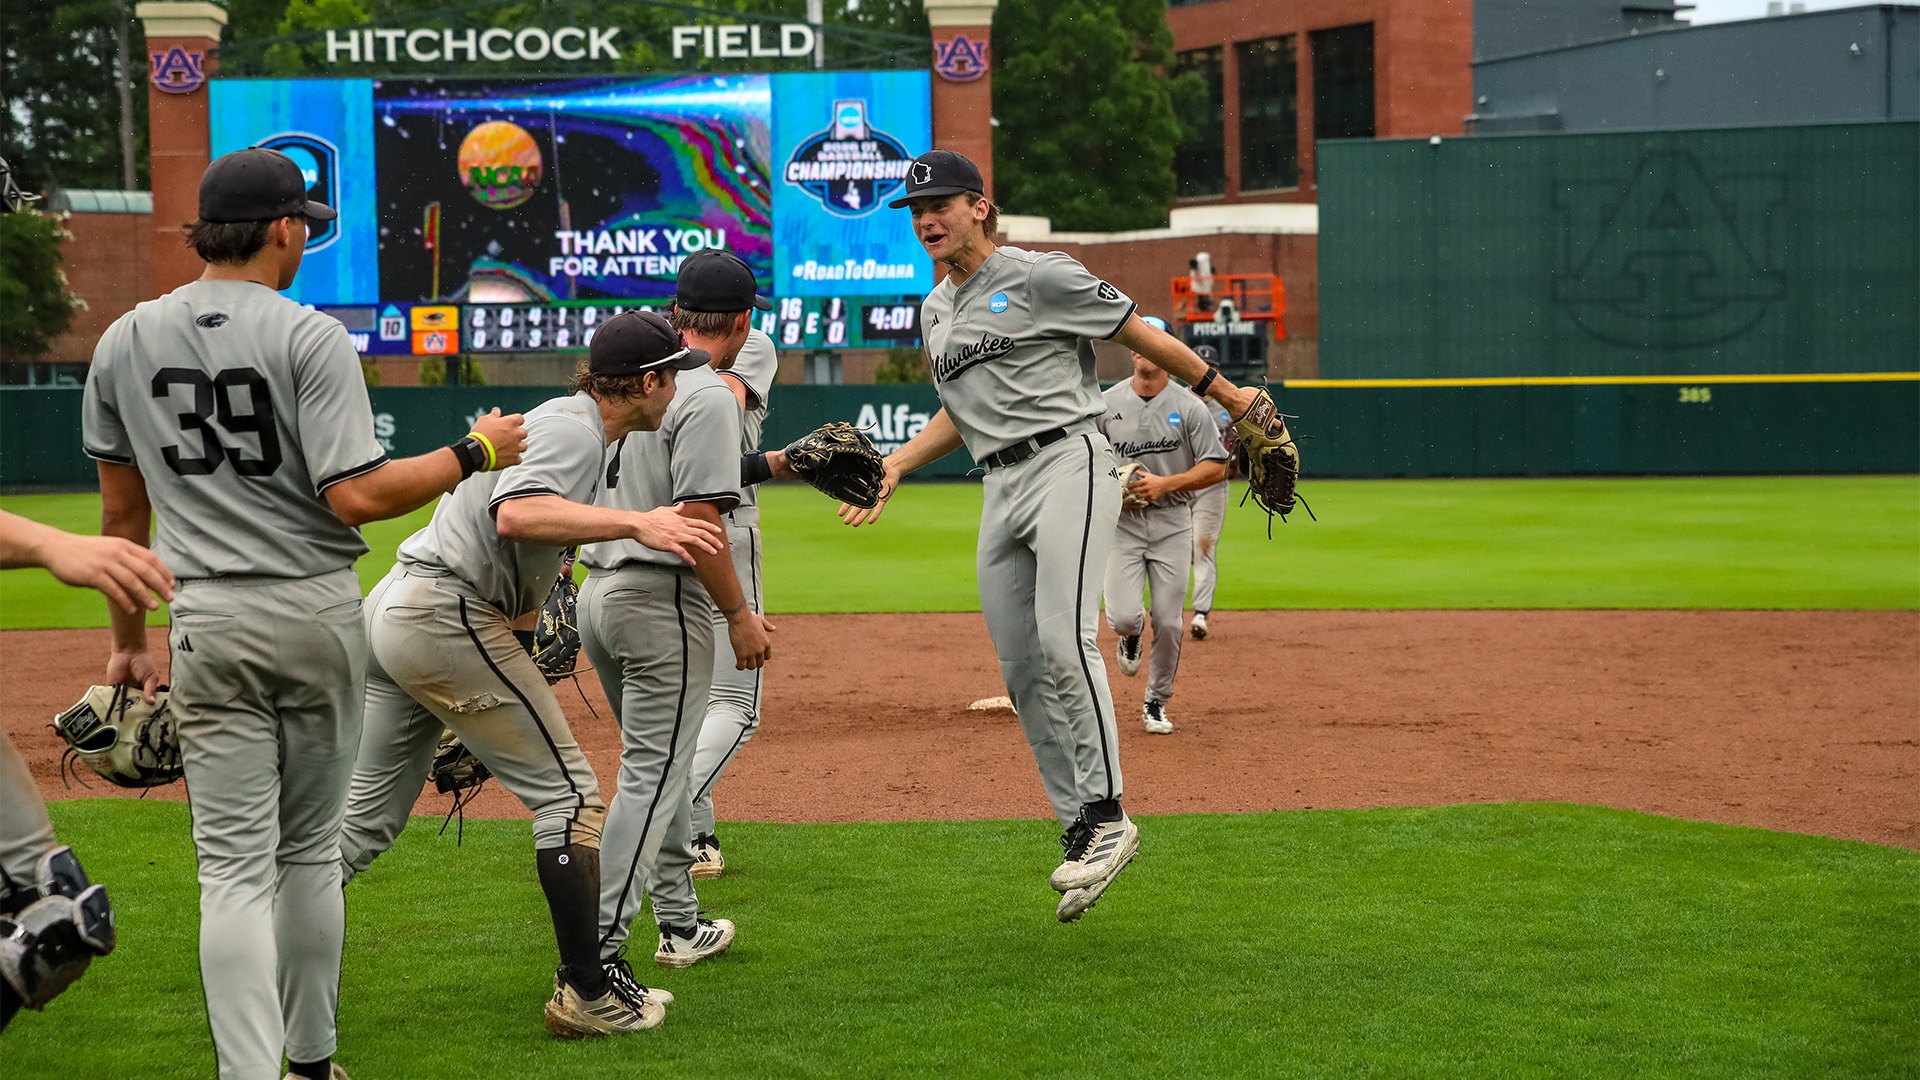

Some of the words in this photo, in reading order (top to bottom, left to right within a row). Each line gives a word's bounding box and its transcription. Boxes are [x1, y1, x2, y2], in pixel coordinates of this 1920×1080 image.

[325, 27, 622, 63] HITCHCOCK
[672, 23, 816, 59] FIELD
[469, 166, 540, 188] NCAA
[555, 228, 658, 254] THANK
[663, 228, 726, 252] YOU
[550, 256, 599, 276] FOR
[472, 307, 486, 327] 2
[501, 307, 514, 327] 0
[528, 307, 542, 326] 4
[558, 306, 567, 326] 1
[584, 306, 597, 326] 0
[781, 298, 803, 320] 16
[831, 297, 841, 320] 1
[869, 306, 915, 331] 4:01
[384, 321, 401, 336] 10
[760, 313, 777, 335] H
[783, 321, 799, 345] 9
[805, 312, 820, 334] E
[828, 321, 845, 344] 0
[1193, 322, 1226, 336] PITCH
[1227, 321, 1256, 335] TIME
[473, 328, 486, 349] 0
[501, 328, 514, 349] 0
[528, 328, 542, 348] 3
[556, 328, 570, 347] 2
[151, 366, 284, 477] 39
[855, 403, 931, 441] Alfa
[1113, 436, 1182, 459] Milwaukee
